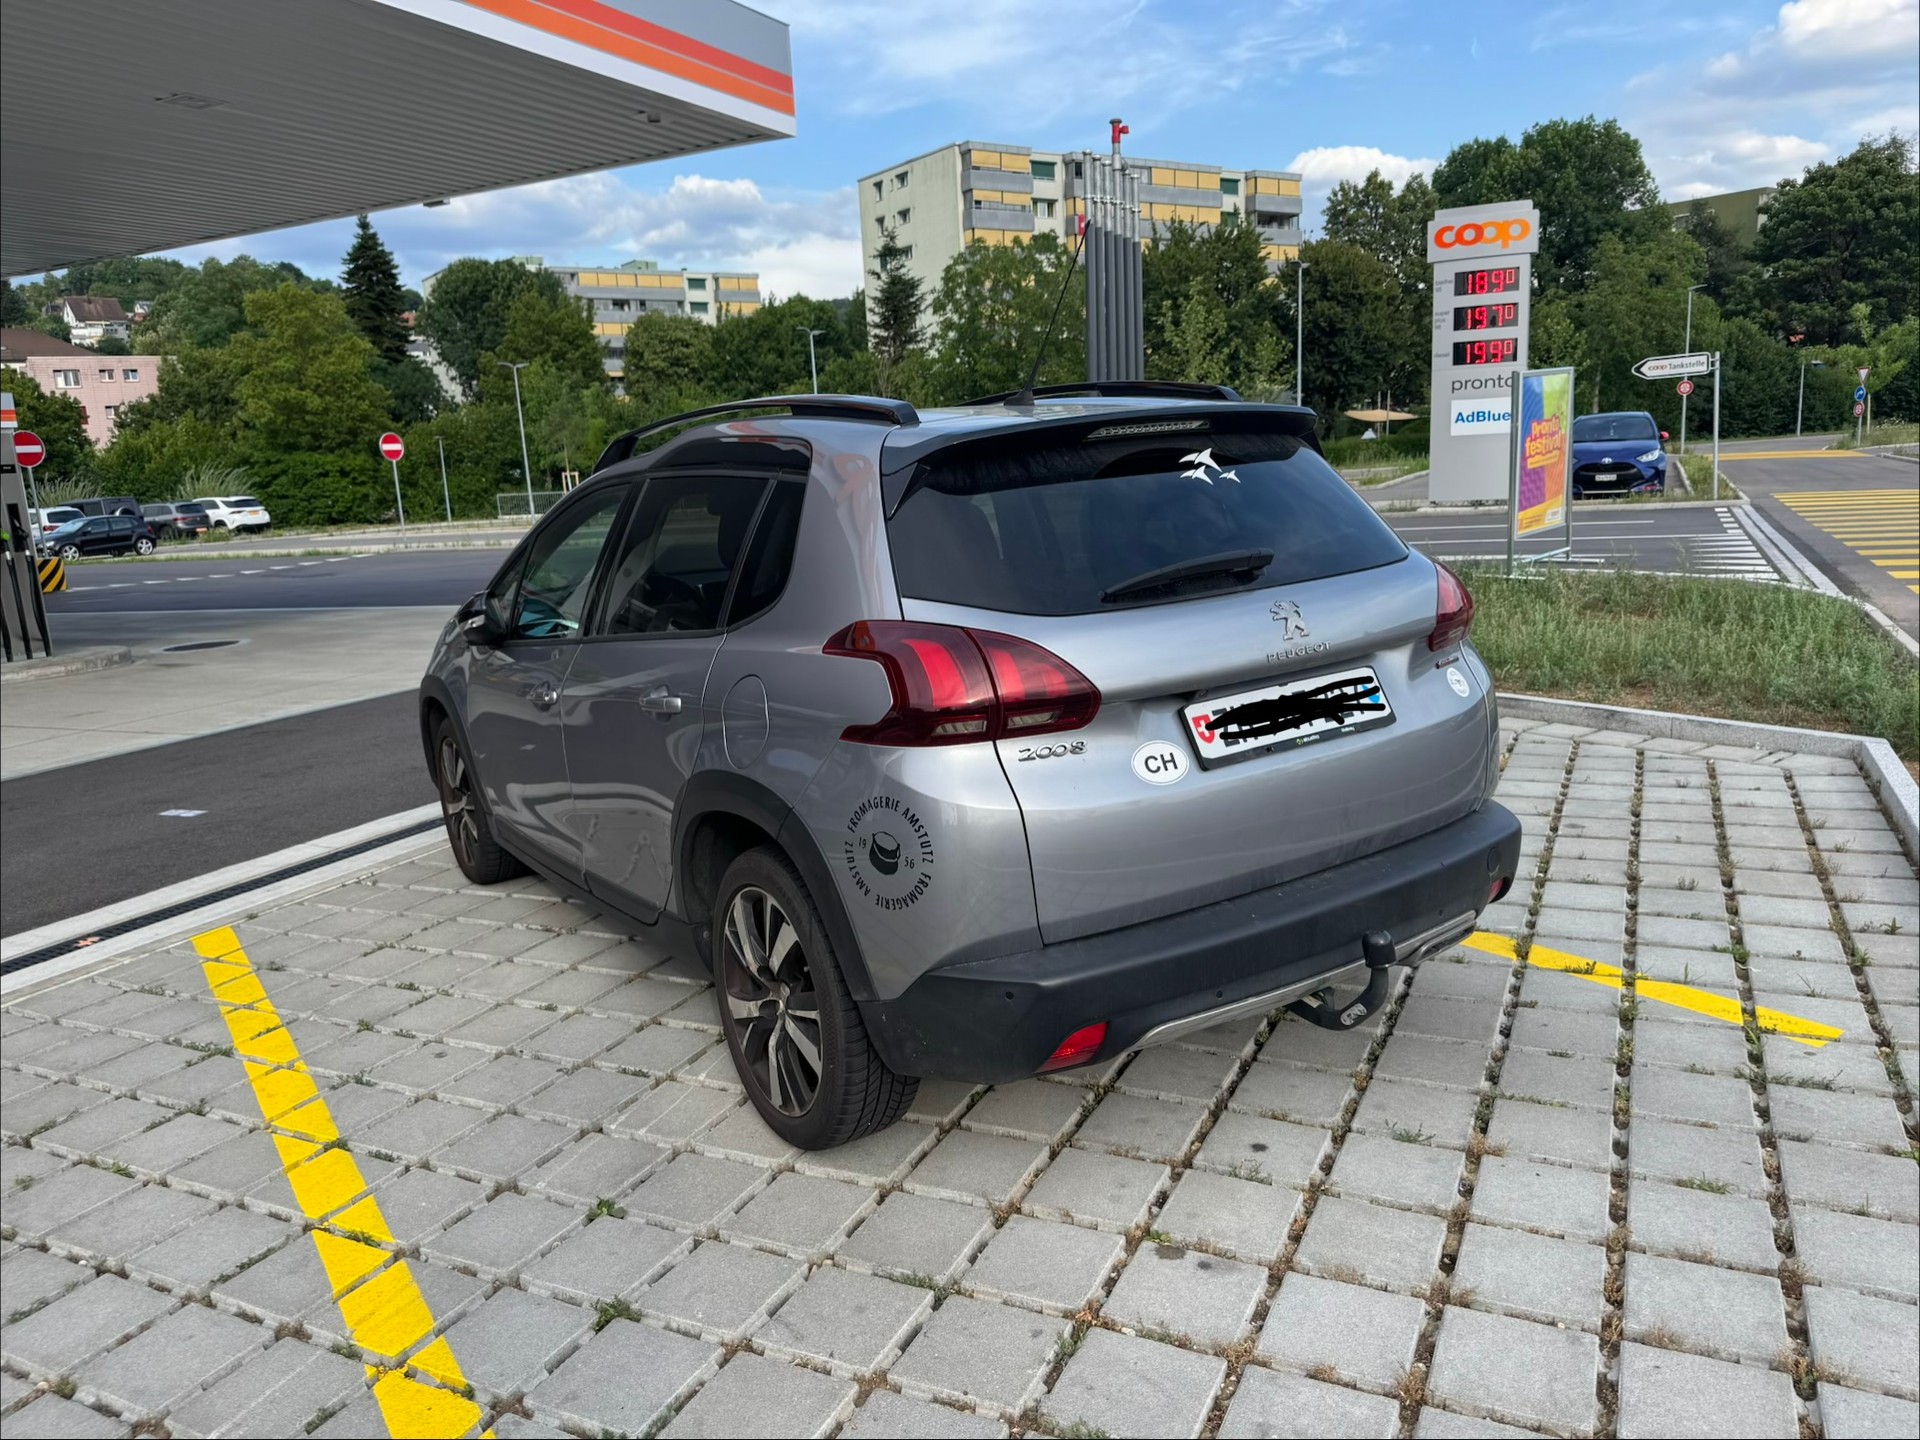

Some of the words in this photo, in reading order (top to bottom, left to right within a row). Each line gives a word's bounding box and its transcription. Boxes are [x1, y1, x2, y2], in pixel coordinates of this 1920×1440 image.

[1434, 218, 1531, 249] coop
[1668, 360, 1705, 370] Tankstelle
[1454, 410, 1511, 423] AdBlue
[1266, 641, 1330, 663] PEUGEOT
[1018, 739, 1088, 762] 2008
[1144, 752, 1178, 774] CH
[847, 796, 901, 833] FROMAGERIE
[901, 807, 934, 864] AMSTUTZ
[858, 837, 867, 848] 19
[844, 840, 871, 897] AMSTUTZ
[904, 856, 915, 869] 56
[875, 872, 932, 911] FROMAGERIE
